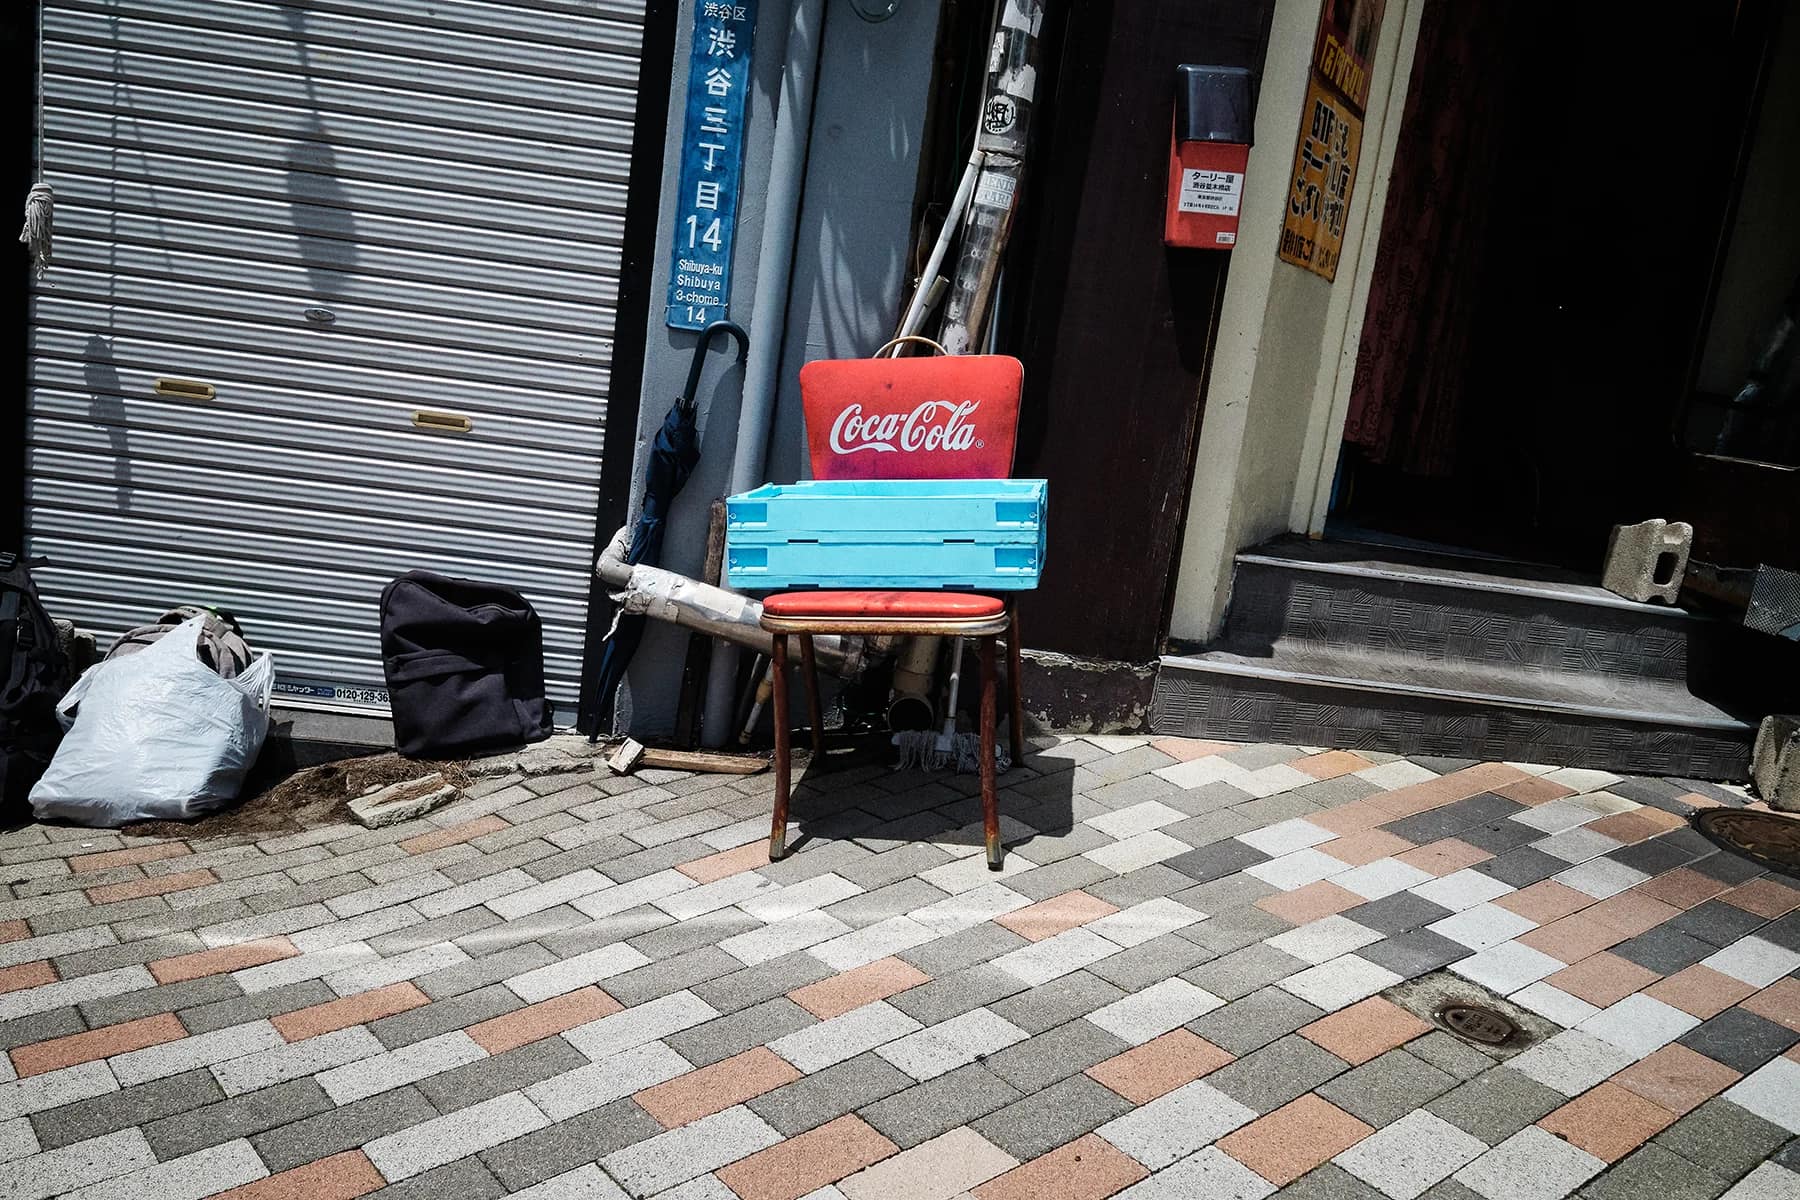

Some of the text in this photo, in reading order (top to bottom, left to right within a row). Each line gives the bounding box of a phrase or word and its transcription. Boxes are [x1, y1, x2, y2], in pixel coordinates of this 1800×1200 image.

[704, 2, 746, 21] 渋谷区
[1192, 171, 1235, 184] ターリー屋
[686, 214, 722, 252] 14
[679, 259, 723, 275] Shibuya-ku
[677, 274, 721, 291] Shibuya
[676, 289, 720, 305] 3-chome
[686, 306, 706, 324] 14
[829, 399, 980, 455] Coca-Cola
[336, 688, 390, 703] 0120-129-36
